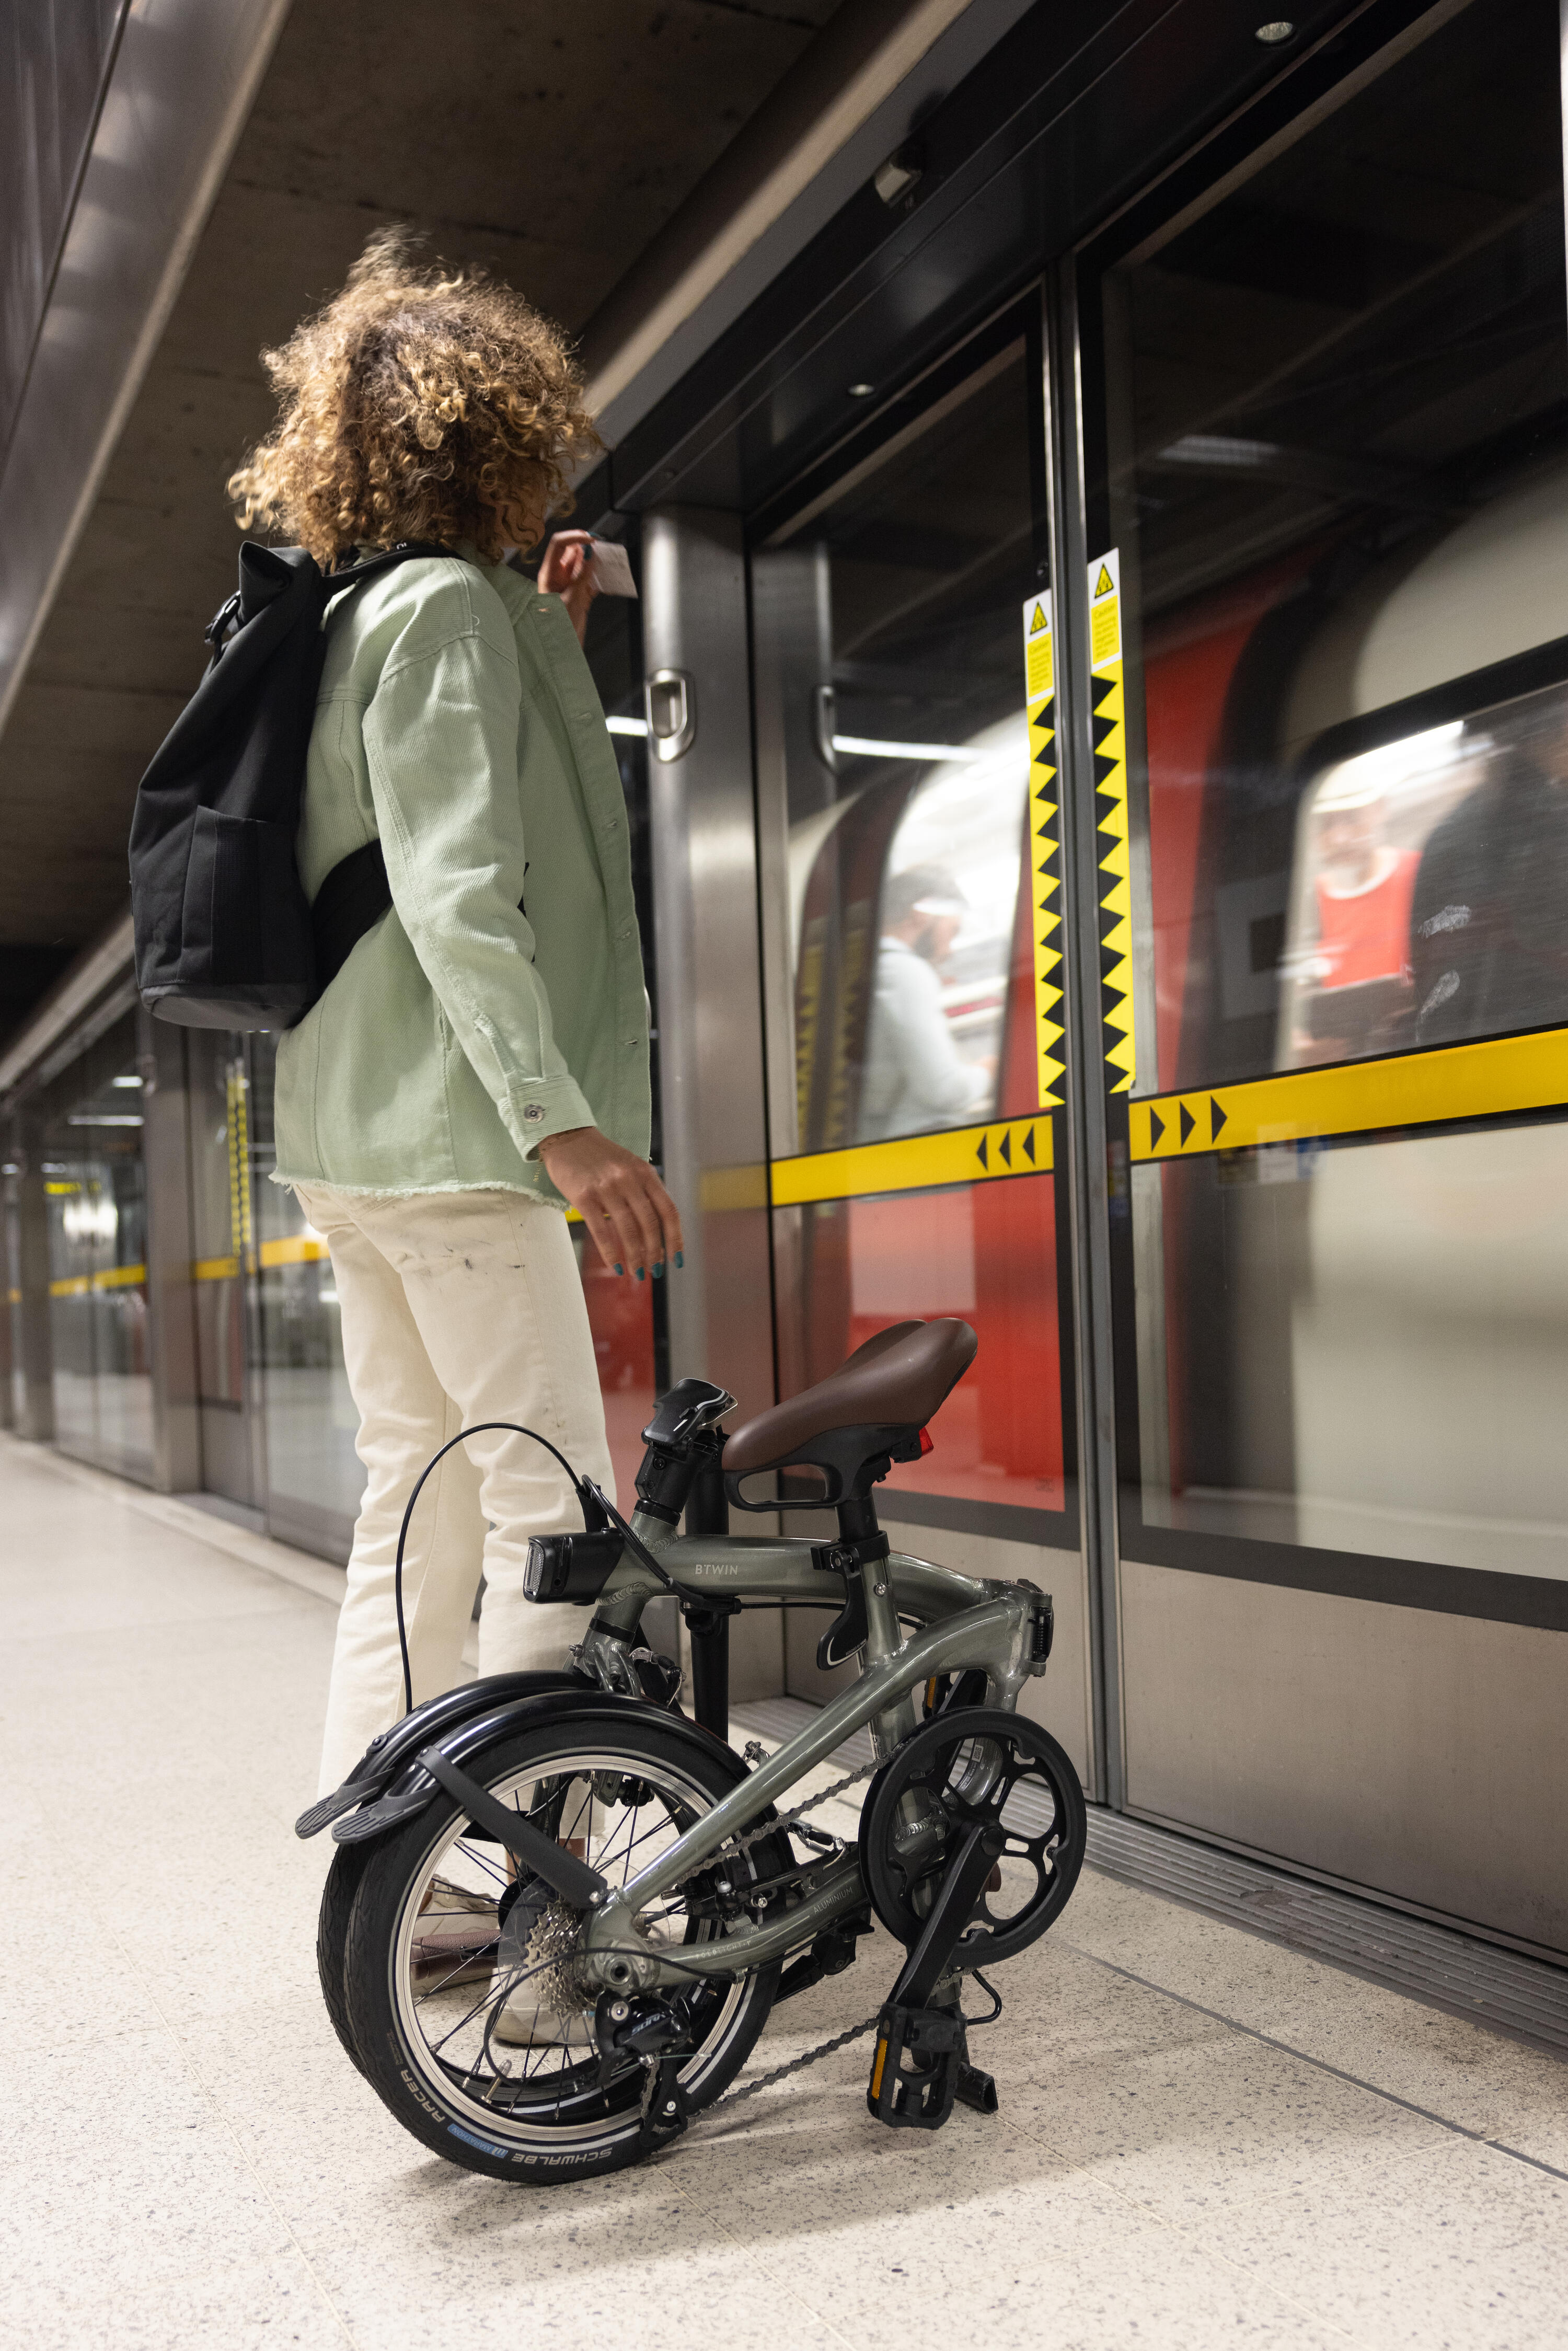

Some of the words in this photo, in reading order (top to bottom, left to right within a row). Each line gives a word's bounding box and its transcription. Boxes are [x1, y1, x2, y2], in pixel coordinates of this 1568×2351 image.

[814, 1886, 852, 1914] ALUMINIUM
[401, 2069, 446, 2123] RACER
[452, 2127, 491, 2151] MARATHON
[512, 2147, 613, 2165] SCHWALBE
